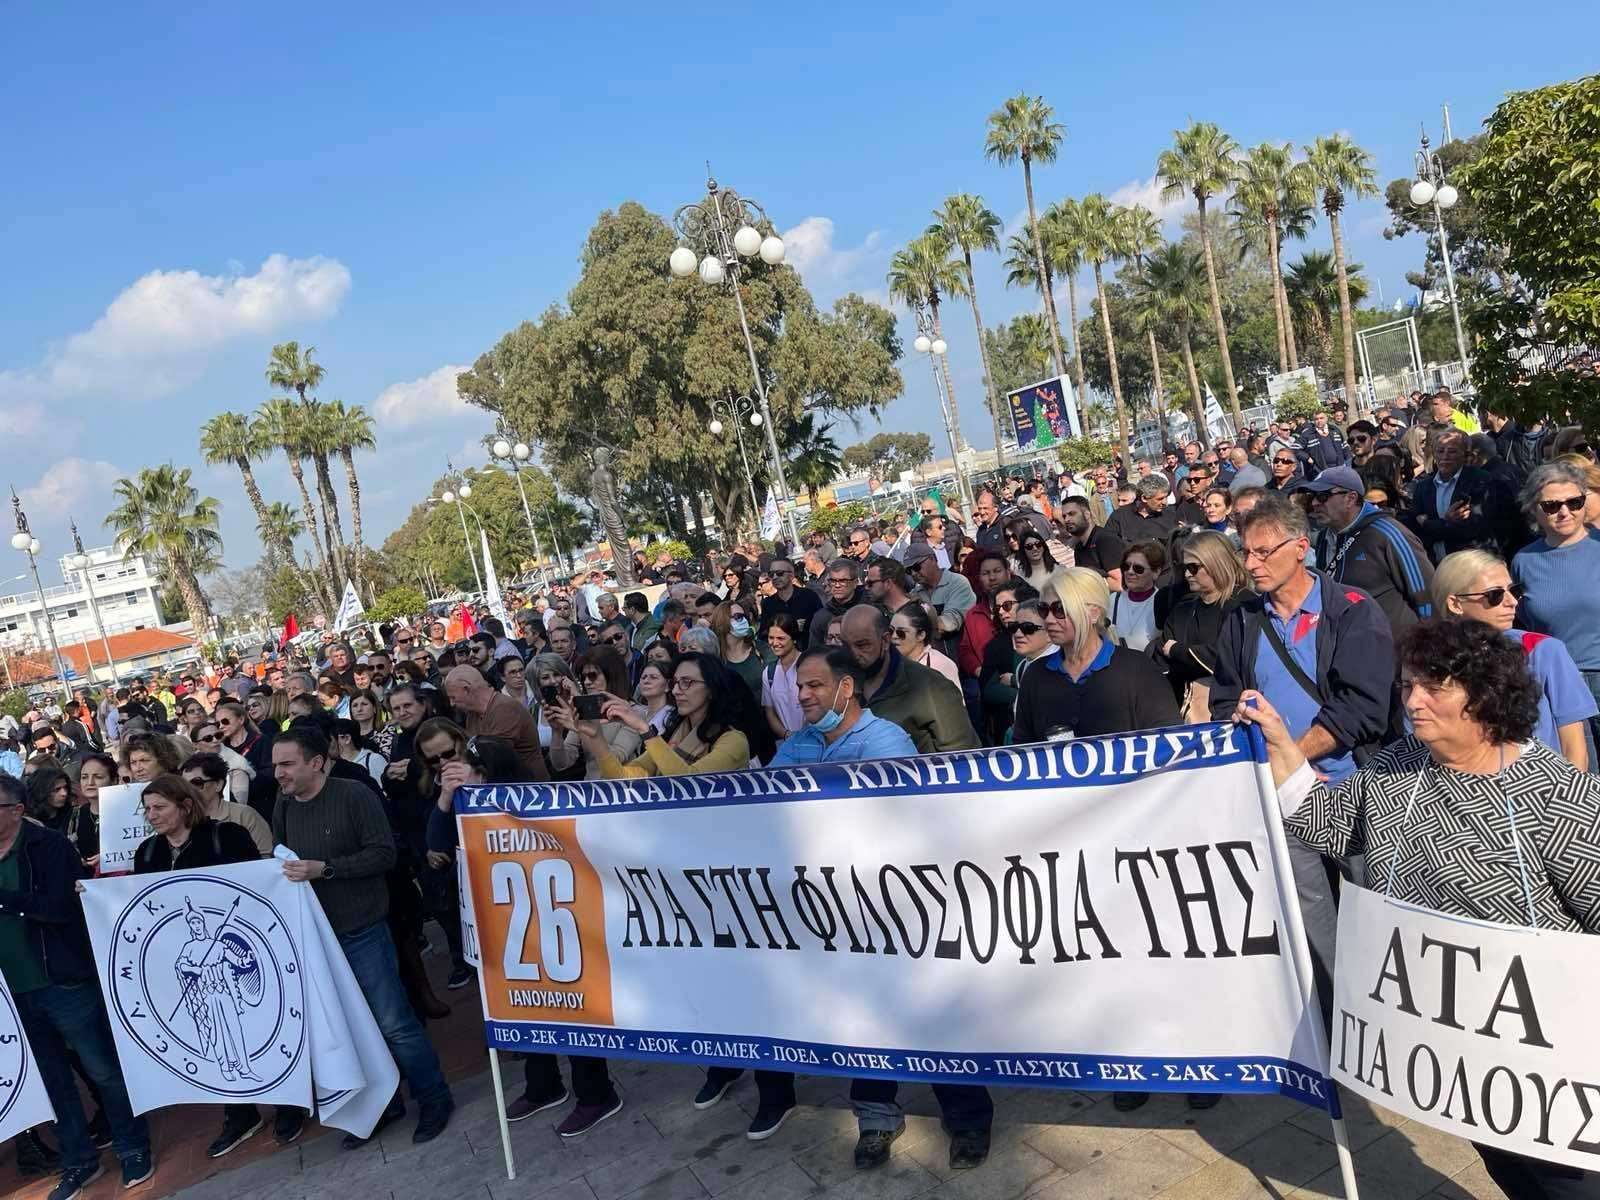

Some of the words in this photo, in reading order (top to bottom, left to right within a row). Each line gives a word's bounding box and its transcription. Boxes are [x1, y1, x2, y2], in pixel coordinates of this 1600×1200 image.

[490, 858, 583, 983] 26
[614, 866, 703, 947] ΑΤΑ
[682, 865, 801, 950] ΣΤΗ
[791, 848, 1122, 965] ΦΙΛΟΣΟΦΙΑ
[1114, 840, 1281, 960] ΤΗΣ
[508, 989, 584, 1009] ΙΑΝΟΥΑΡΙΟΥ
[1368, 926, 1554, 1049] ΑΤΑ
[494, 1027, 521, 1042] ΠΕΟ
[531, 1029, 558, 1045] ΣΕΚ
[568, 1031, 626, 1049] ΠΑΣΥΔΥ
[638, 1037, 680, 1053] ΔΕΟΚ
[691, 1039, 761, 1059] ΟΕΛΜΕΚ
[772, 1045, 820, 1064] ΠΟΕΔ
[832, 1051, 895, 1070] ΟΛΤΕΚ
[905, 1056, 979, 1074] ΠΟΑΣΟ
[994, 1059, 1082, 1079] ΠΑΣΥΚΙ
[1097, 1063, 1148, 1081] ΕΣΚ
[1164, 1064, 1220, 1081] ΣΑΚ
[1237, 1064, 1326, 1099] ΣΥΠΥΚ
[1337, 1008, 1394, 1097] ΓΙΑ
[1406, 1043, 1600, 1156] ΟΛΟΥΣ
